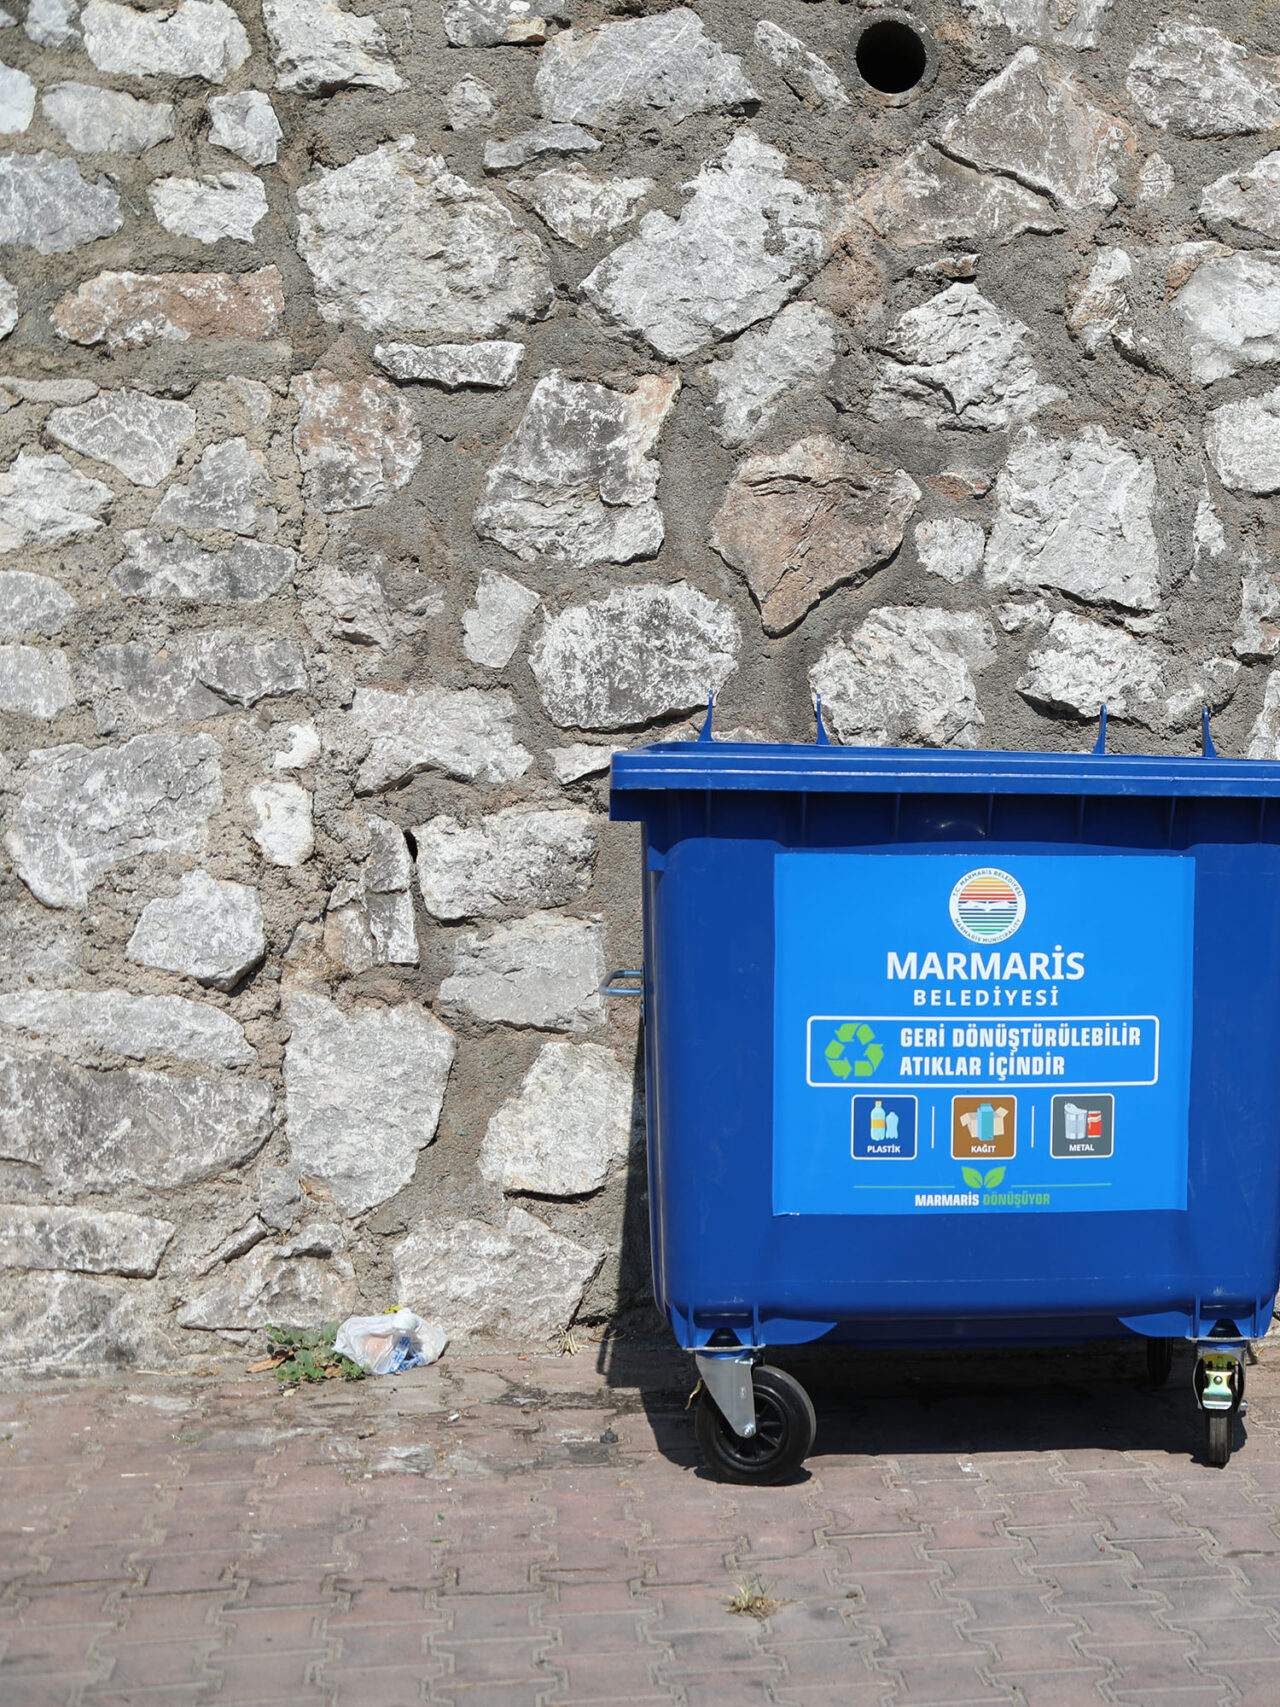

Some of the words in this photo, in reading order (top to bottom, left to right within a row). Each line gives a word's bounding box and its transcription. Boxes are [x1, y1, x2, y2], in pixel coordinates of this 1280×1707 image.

[887, 945, 1085, 981] MARMARİS
[913, 986, 1059, 1006] BELEDİYESİ
[900, 1022, 945, 1048] GERİ
[952, 1022, 1141, 1053] DÖNÜŞTÜRÜLEBİLİR
[900, 1056, 982, 1076] ATIKLAR
[989, 1053, 1065, 1081] İÇİNDİR
[866, 1143, 901, 1154] PLASTİK
[970, 1143, 997, 1154] KAĞIT
[1068, 1143, 1095, 1153] METAL
[914, 1191, 980, 1207] MARMARİS
[982, 1191, 1051, 1209] DÖNÜŞÜYOR
